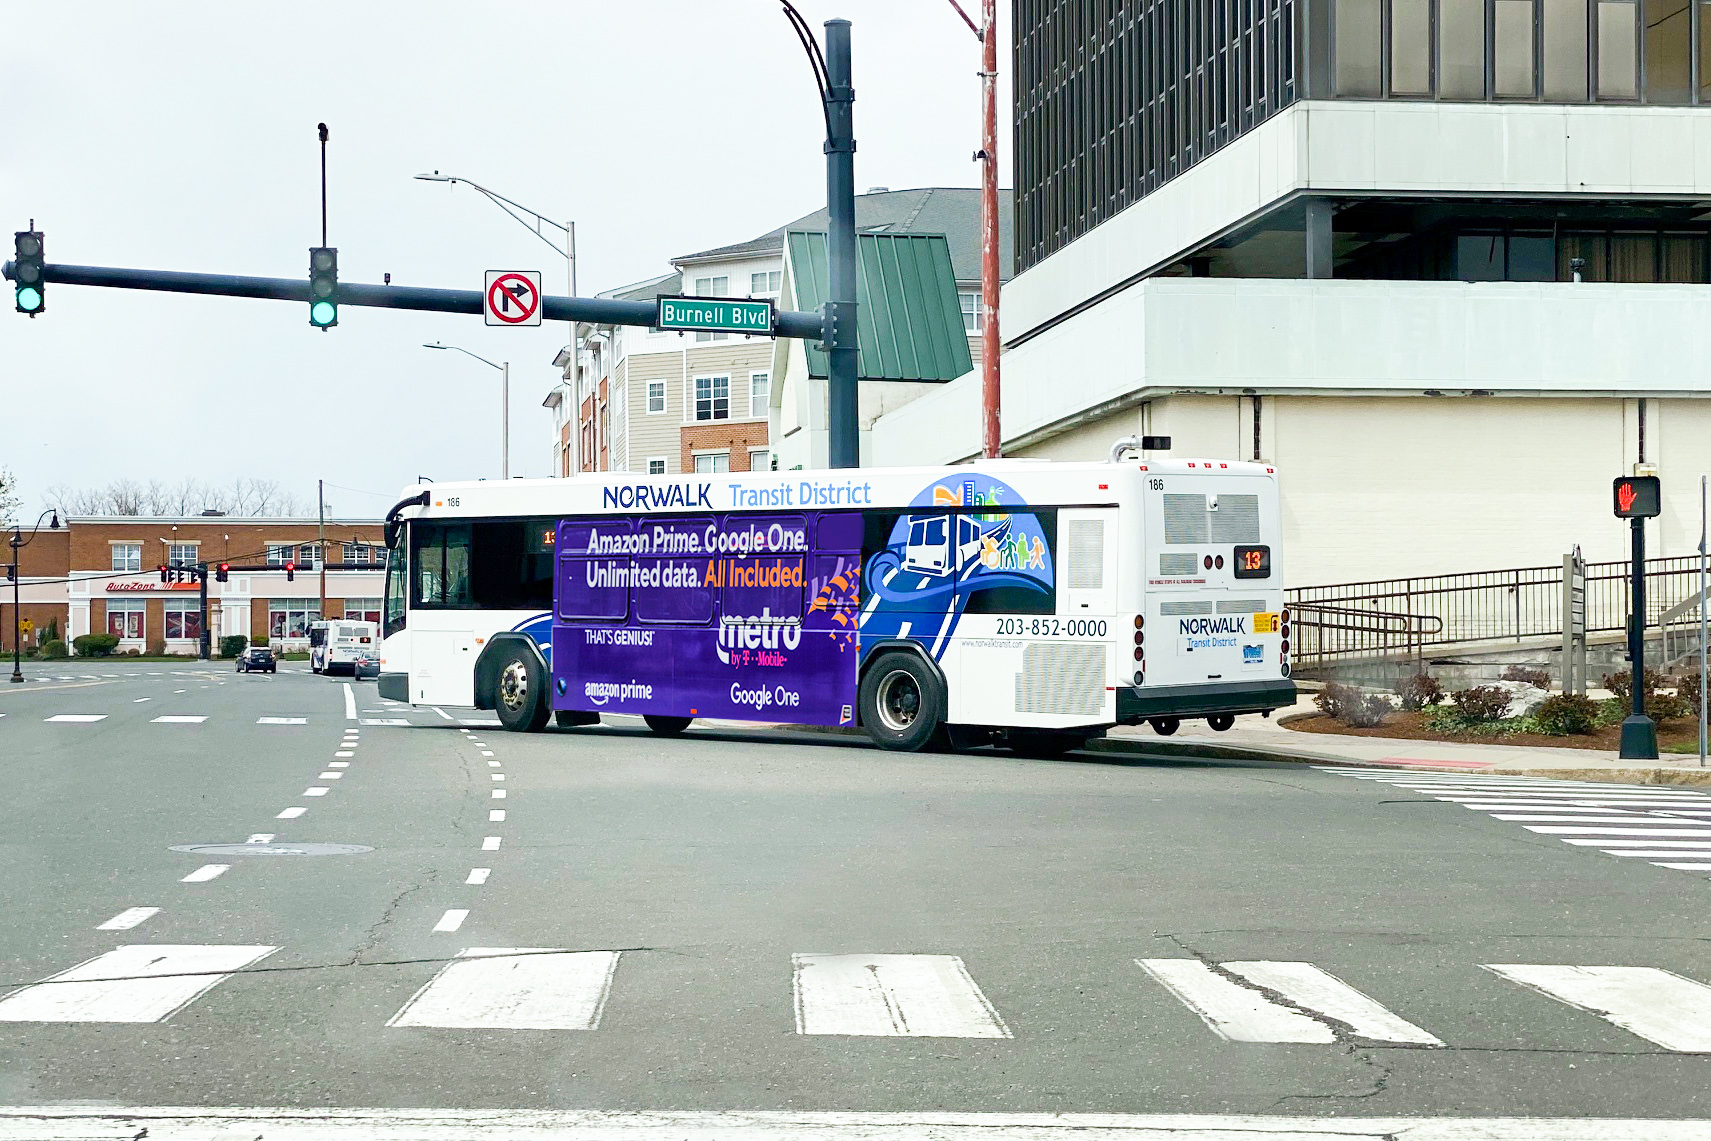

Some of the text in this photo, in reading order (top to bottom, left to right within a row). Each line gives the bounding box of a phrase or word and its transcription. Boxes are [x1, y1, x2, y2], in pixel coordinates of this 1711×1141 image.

[665, 304, 766, 325] Burnell Blvd
[1149, 478, 1164, 491] 186
[447, 497, 460, 507] 186
[603, 480, 871, 510] NORWALK Transit District
[586, 523, 808, 559] Amazon Prime. Google One.
[1245, 551, 1261, 570] 13
[586, 558, 808, 588] Unlimited data. All Included.
[106, 582, 155, 591] AutoZone
[718, 607, 801, 651] metro
[996, 618, 1107, 637] 203-852-0000
[1180, 617, 1246, 636] NORWALK
[585, 629, 653, 646] THAT'S GENIUS!
[1187, 636, 1237, 648] Transit District
[731, 650, 742, 670] by
[585, 679, 653, 702] amazon prime
[730, 682, 800, 710] Google One
